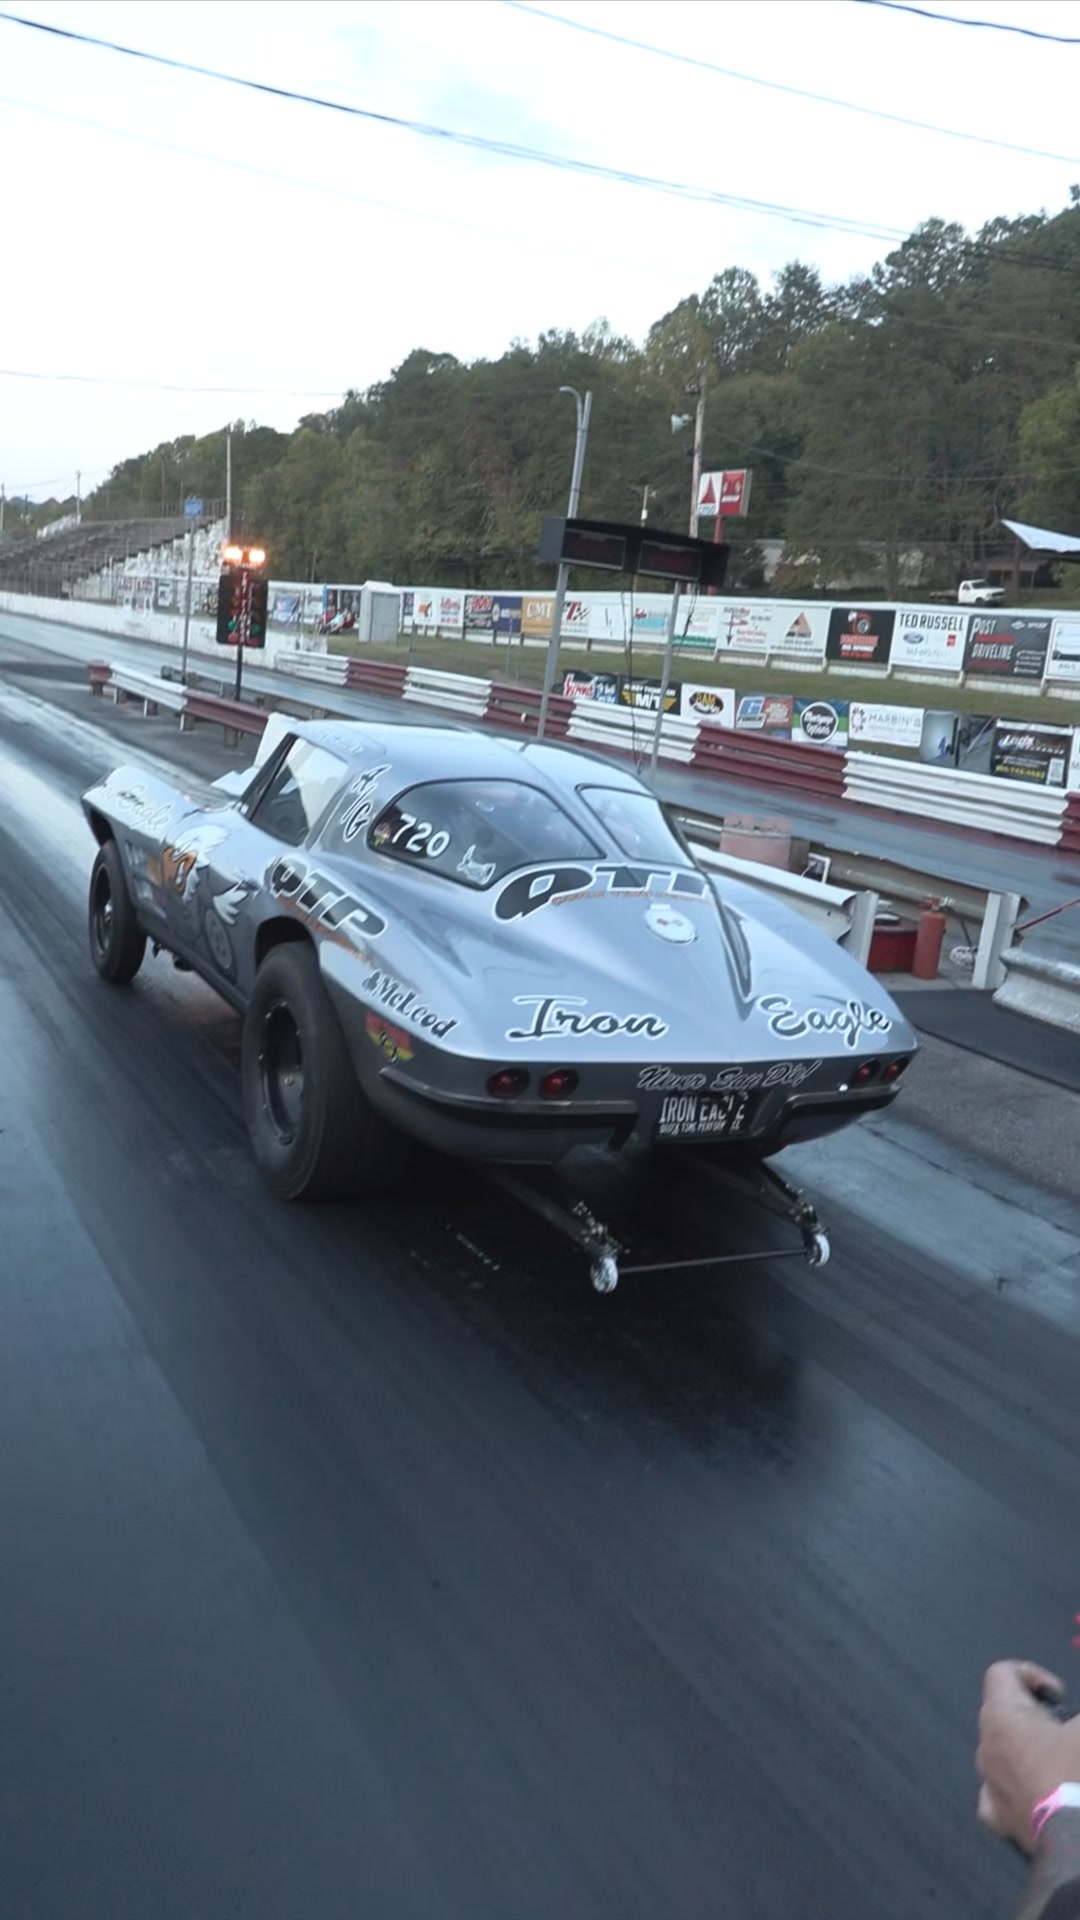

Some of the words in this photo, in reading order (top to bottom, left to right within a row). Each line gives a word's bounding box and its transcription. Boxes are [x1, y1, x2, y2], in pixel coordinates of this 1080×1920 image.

[899, 613, 921, 627] TED
[921, 614, 964, 632] RUSSELL
[969, 617, 997, 642] POST
[971, 643, 1014, 661] DRIVELINE
[868, 713, 921, 728] HARBIN'S
[391, 812, 450, 859] 720
[376, 977, 460, 1042] McLeod
[504, 994, 669, 1042] Iron
[757, 993, 893, 1050] Eagle
[659, 1095, 698, 1124] IRON
